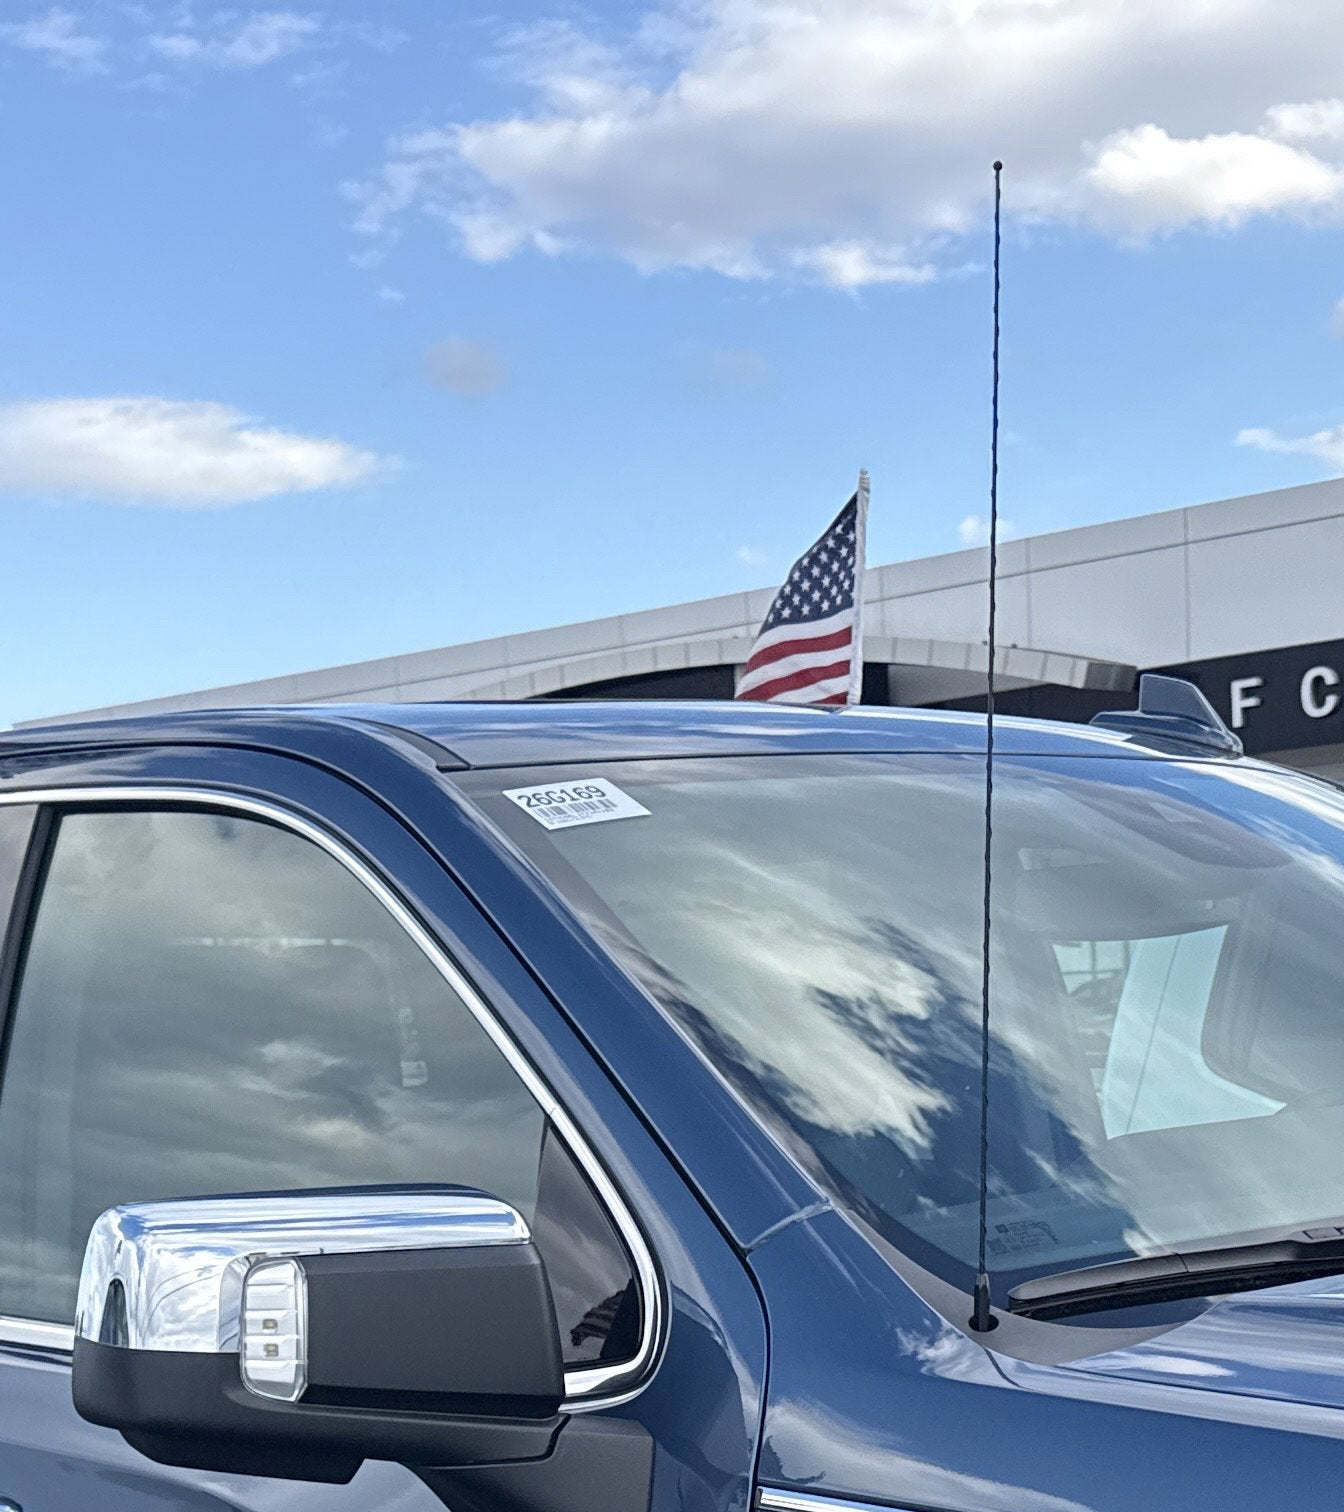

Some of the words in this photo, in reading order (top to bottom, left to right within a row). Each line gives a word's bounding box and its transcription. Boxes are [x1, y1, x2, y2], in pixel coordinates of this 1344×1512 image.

[1229, 677, 1265, 730] F
[1300, 666, 1341, 719] C
[517, 785, 606, 809] 26G169
